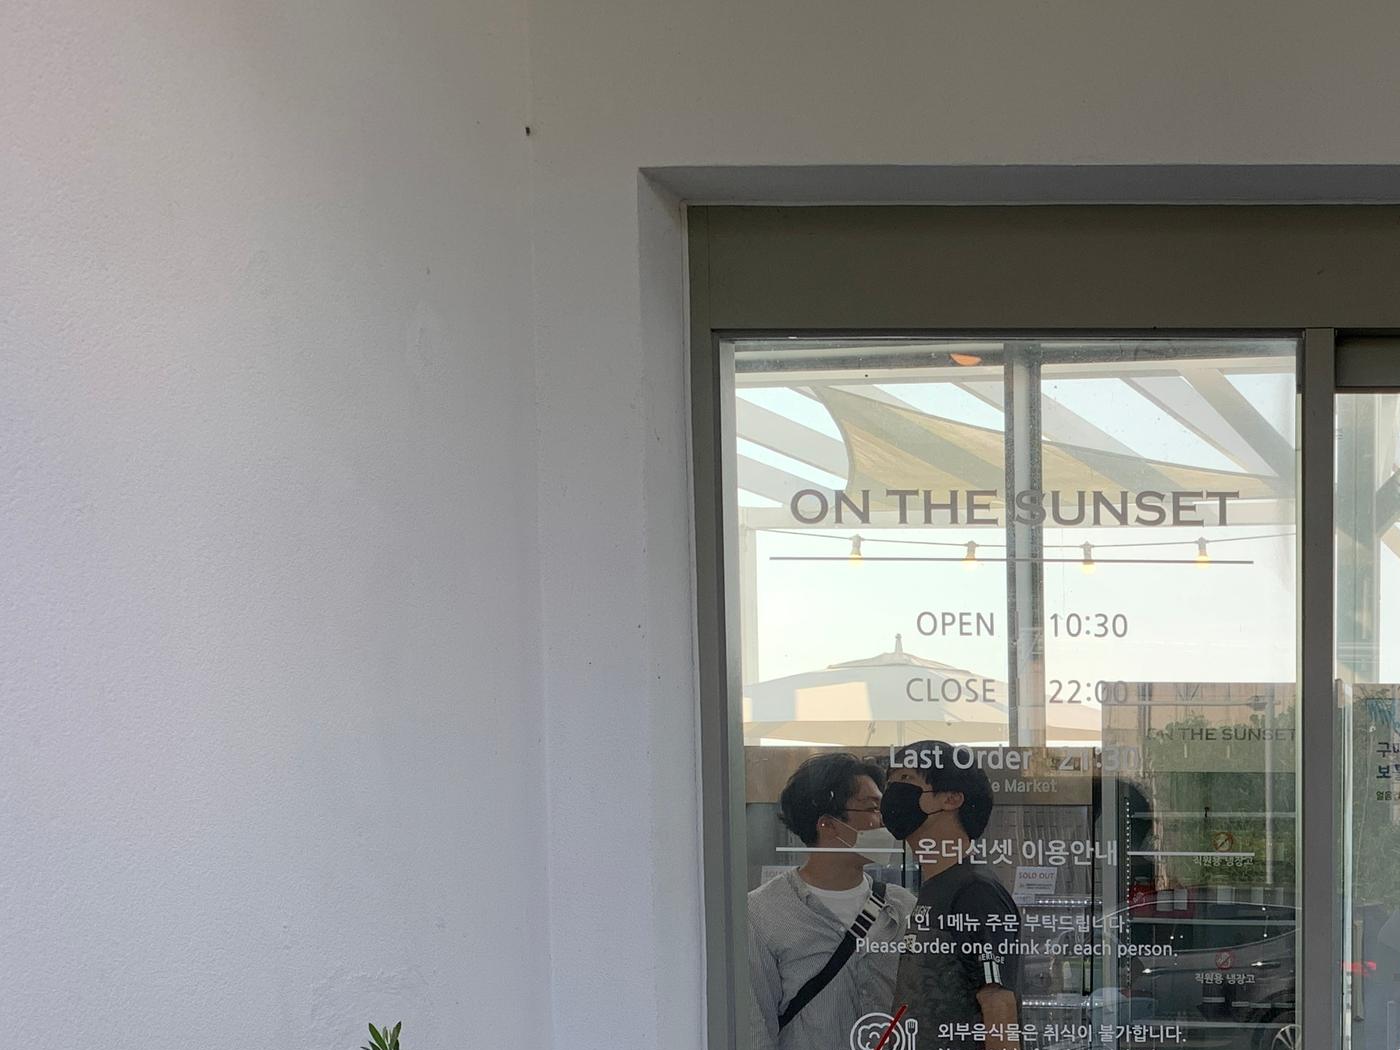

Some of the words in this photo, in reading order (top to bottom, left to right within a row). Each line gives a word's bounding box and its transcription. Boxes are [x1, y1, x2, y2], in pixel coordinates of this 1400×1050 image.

[789, 488, 872, 525] ON
[886, 488, 999, 526] THE
[1014, 488, 1240, 528] SUNSET
[915, 611, 996, 637] OPEN
[1049, 612, 1129, 639] 10:30
[905, 677, 996, 704] CLOSE
[1049, 680, 1129, 705] 22:00
[1178, 728, 1216, 741] THE
[1222, 728, 1295, 742] SUNSET
[889, 744, 945, 770] Last
[952, 742, 1033, 771] Order
[1058, 745, 1140, 772] 21:30
[1005, 779, 1057, 793] Market
[915, 838, 1012, 865] 온더선셋
[1022, 839, 1119, 867] 이용안내
[905, 914, 930, 931] 1인
[937, 914, 981, 932] 1메뉴
[985, 914, 1019, 932] 주문
[1024, 914, 1130, 933] 부탁드립니다.
[855, 937, 907, 953] Please
[911, 938, 957, 954] order
[961, 941, 993, 954] one
[998, 938, 1039, 955] drink
[1044, 939, 1068, 955] for
[1073, 939, 1114, 956] each
[1118, 942, 1178, 958] person.
[1194, 973, 1223, 984] 직원용
[1226, 973, 1256, 984] 냉장고
[937, 1024, 1038, 1044] 외부음식물은
[1043, 1024, 1092, 1043] 취식이
[1098, 1025, 1187, 1044] 불가합니다.
